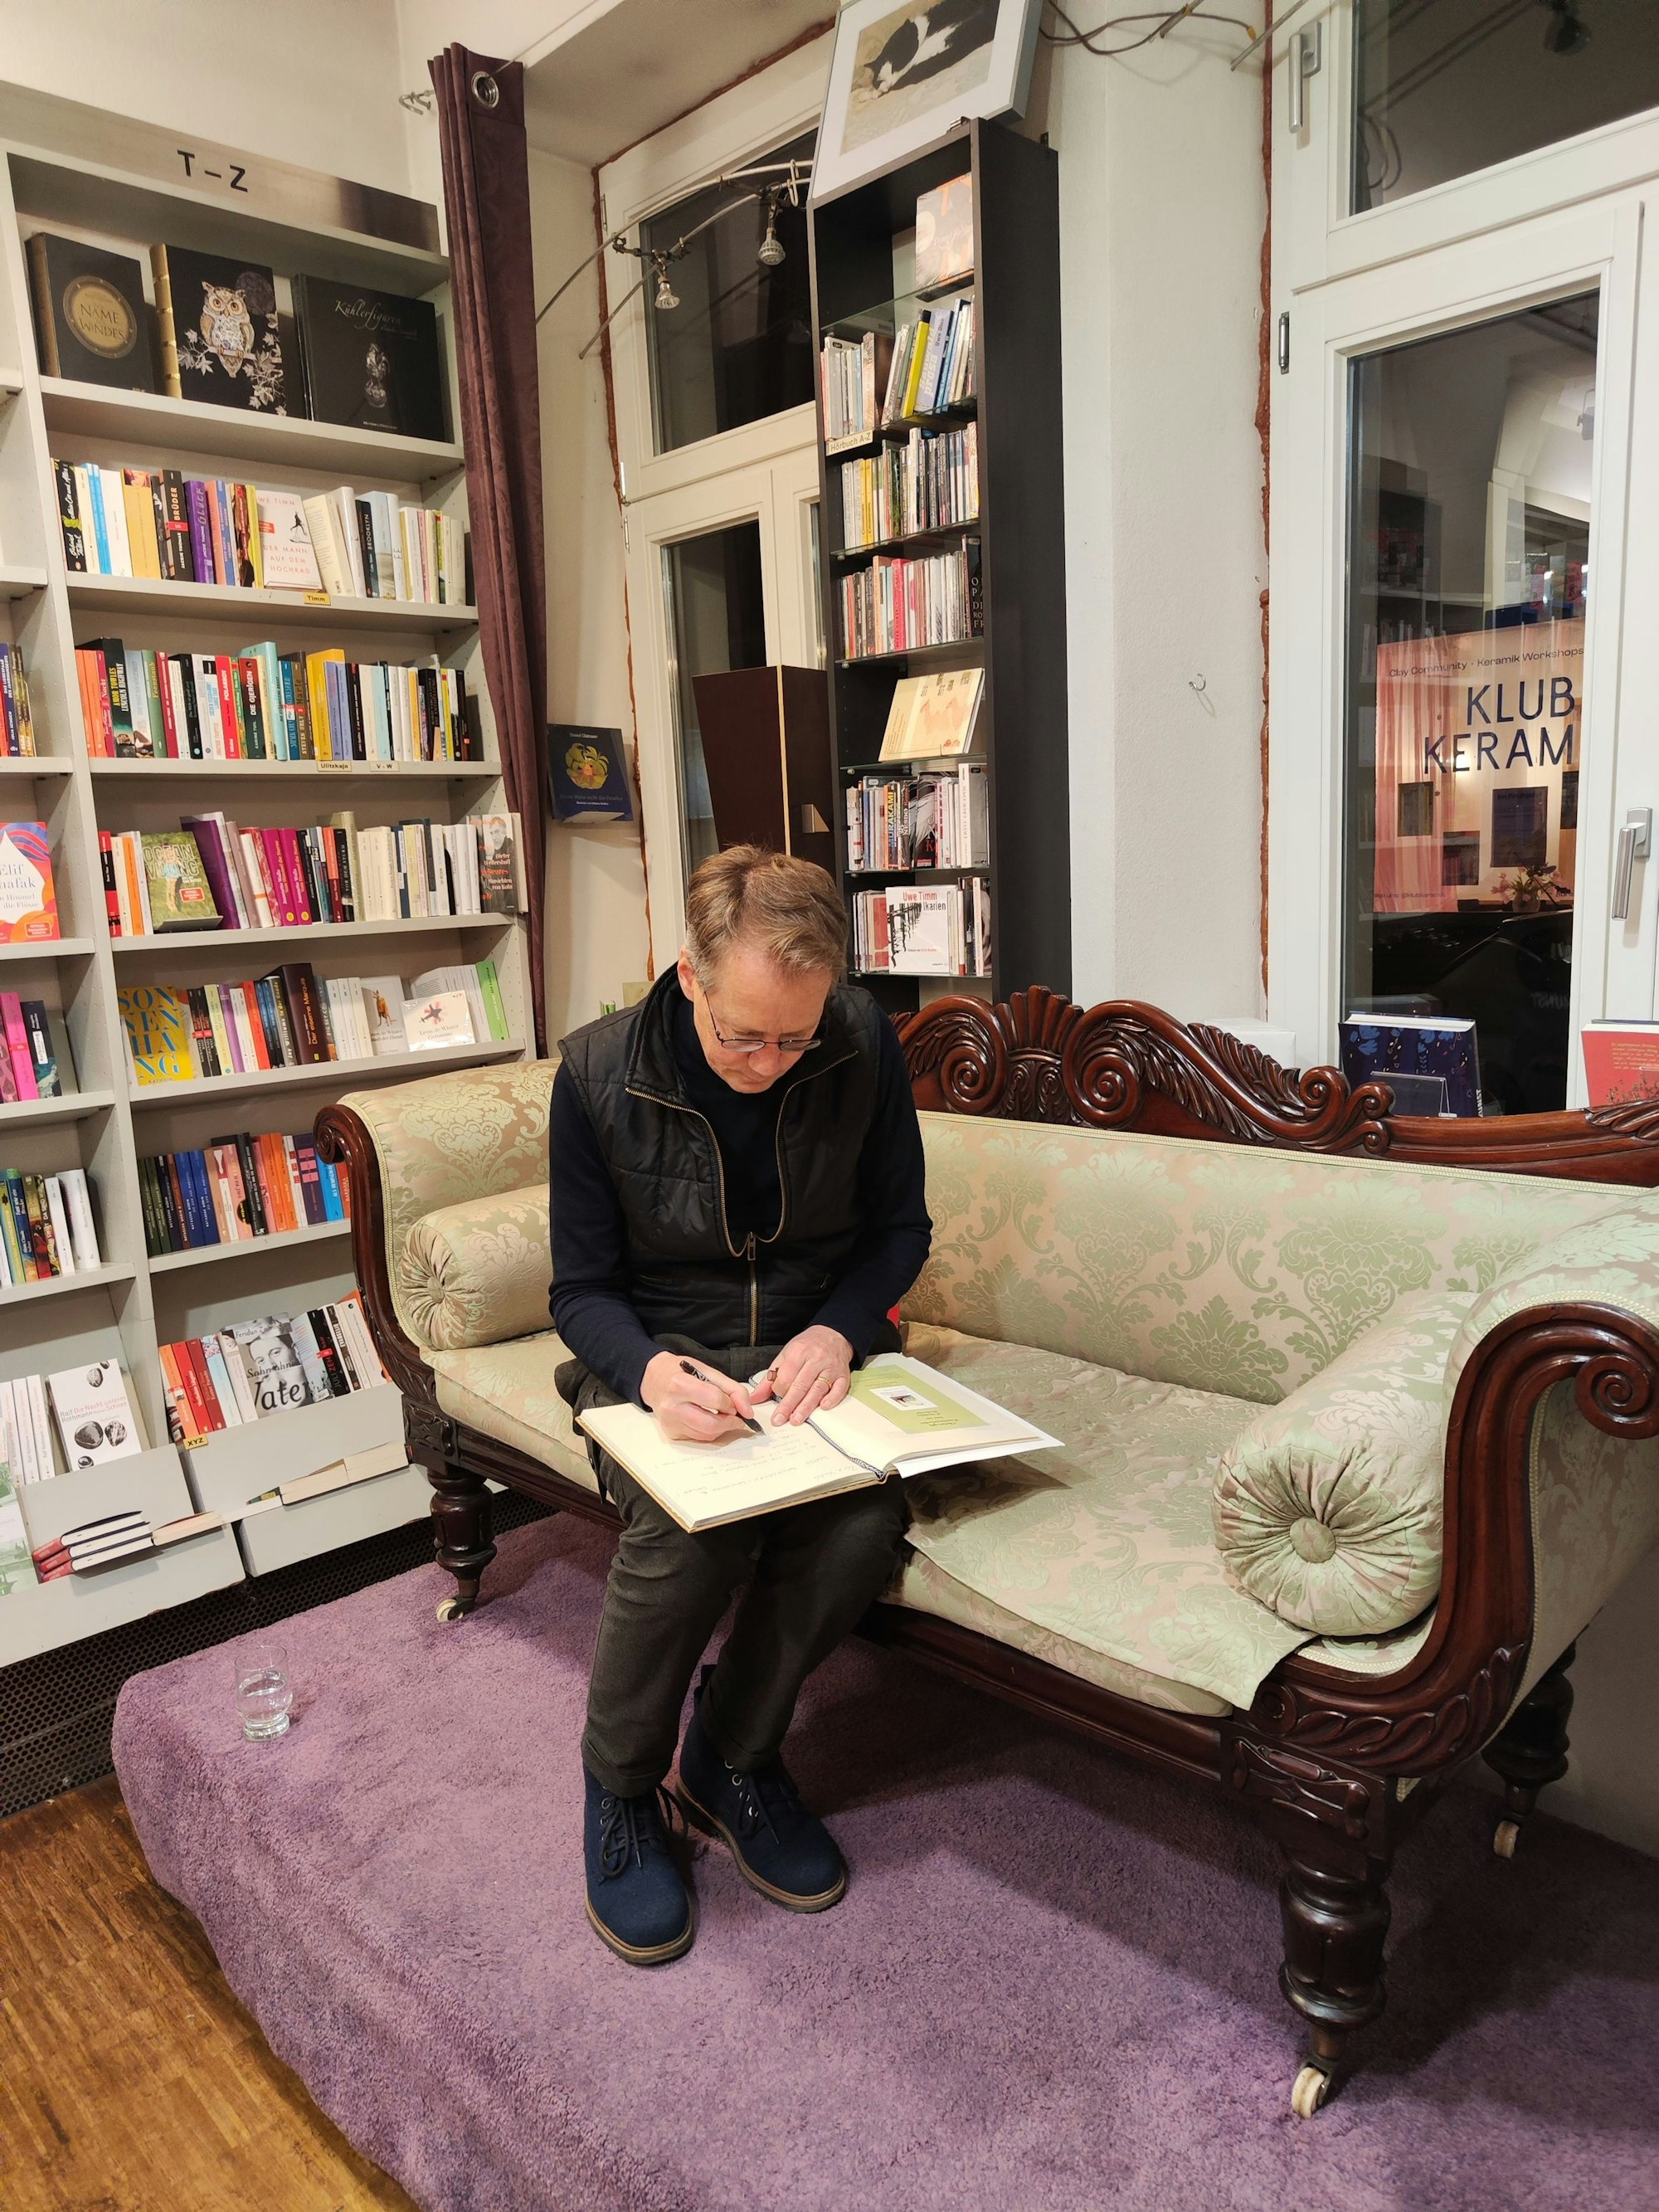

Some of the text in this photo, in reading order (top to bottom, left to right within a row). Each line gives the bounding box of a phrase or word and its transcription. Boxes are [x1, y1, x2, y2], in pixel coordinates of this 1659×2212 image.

[80, 304, 119, 324] NAME
[80, 318, 125, 339] WINDES
[830, 432, 871, 453] Hörbuch A-Z
[170, 486, 180, 521] BRÜDER
[197, 487, 206, 524] GLÜCK
[363, 514, 373, 550] BROOKLYN
[270, 565, 310, 574] HOCHRAD
[1389, 647, 1585, 678] Clay Community Keramik Workshops
[149, 662, 158, 699] Feenstaub
[294, 679, 302, 704] Marie
[1467, 676, 1576, 726] KLUB
[1423, 724, 1574, 775] KERAM
[903, 891, 937, 901] Uwe Timm
[923, 901, 946, 911] Ikarien
[300, 977, 313, 1006] Marquis
[308, 1006, 316, 1031] eiserne
[282, 1018, 291, 1046] Williams
[135, 1055, 179, 1078] NG
[236, 1329, 258, 1338] Feridun
[247, 1367, 272, 1377] Sohn
[333, 1372, 342, 1389] JULI
[85, 1402, 103, 1411] Nacht
[104, 1396, 126, 1406] unterm
[61, 1411, 93, 1423] Rothmann
[187, 1437, 204, 1446] XYZ
